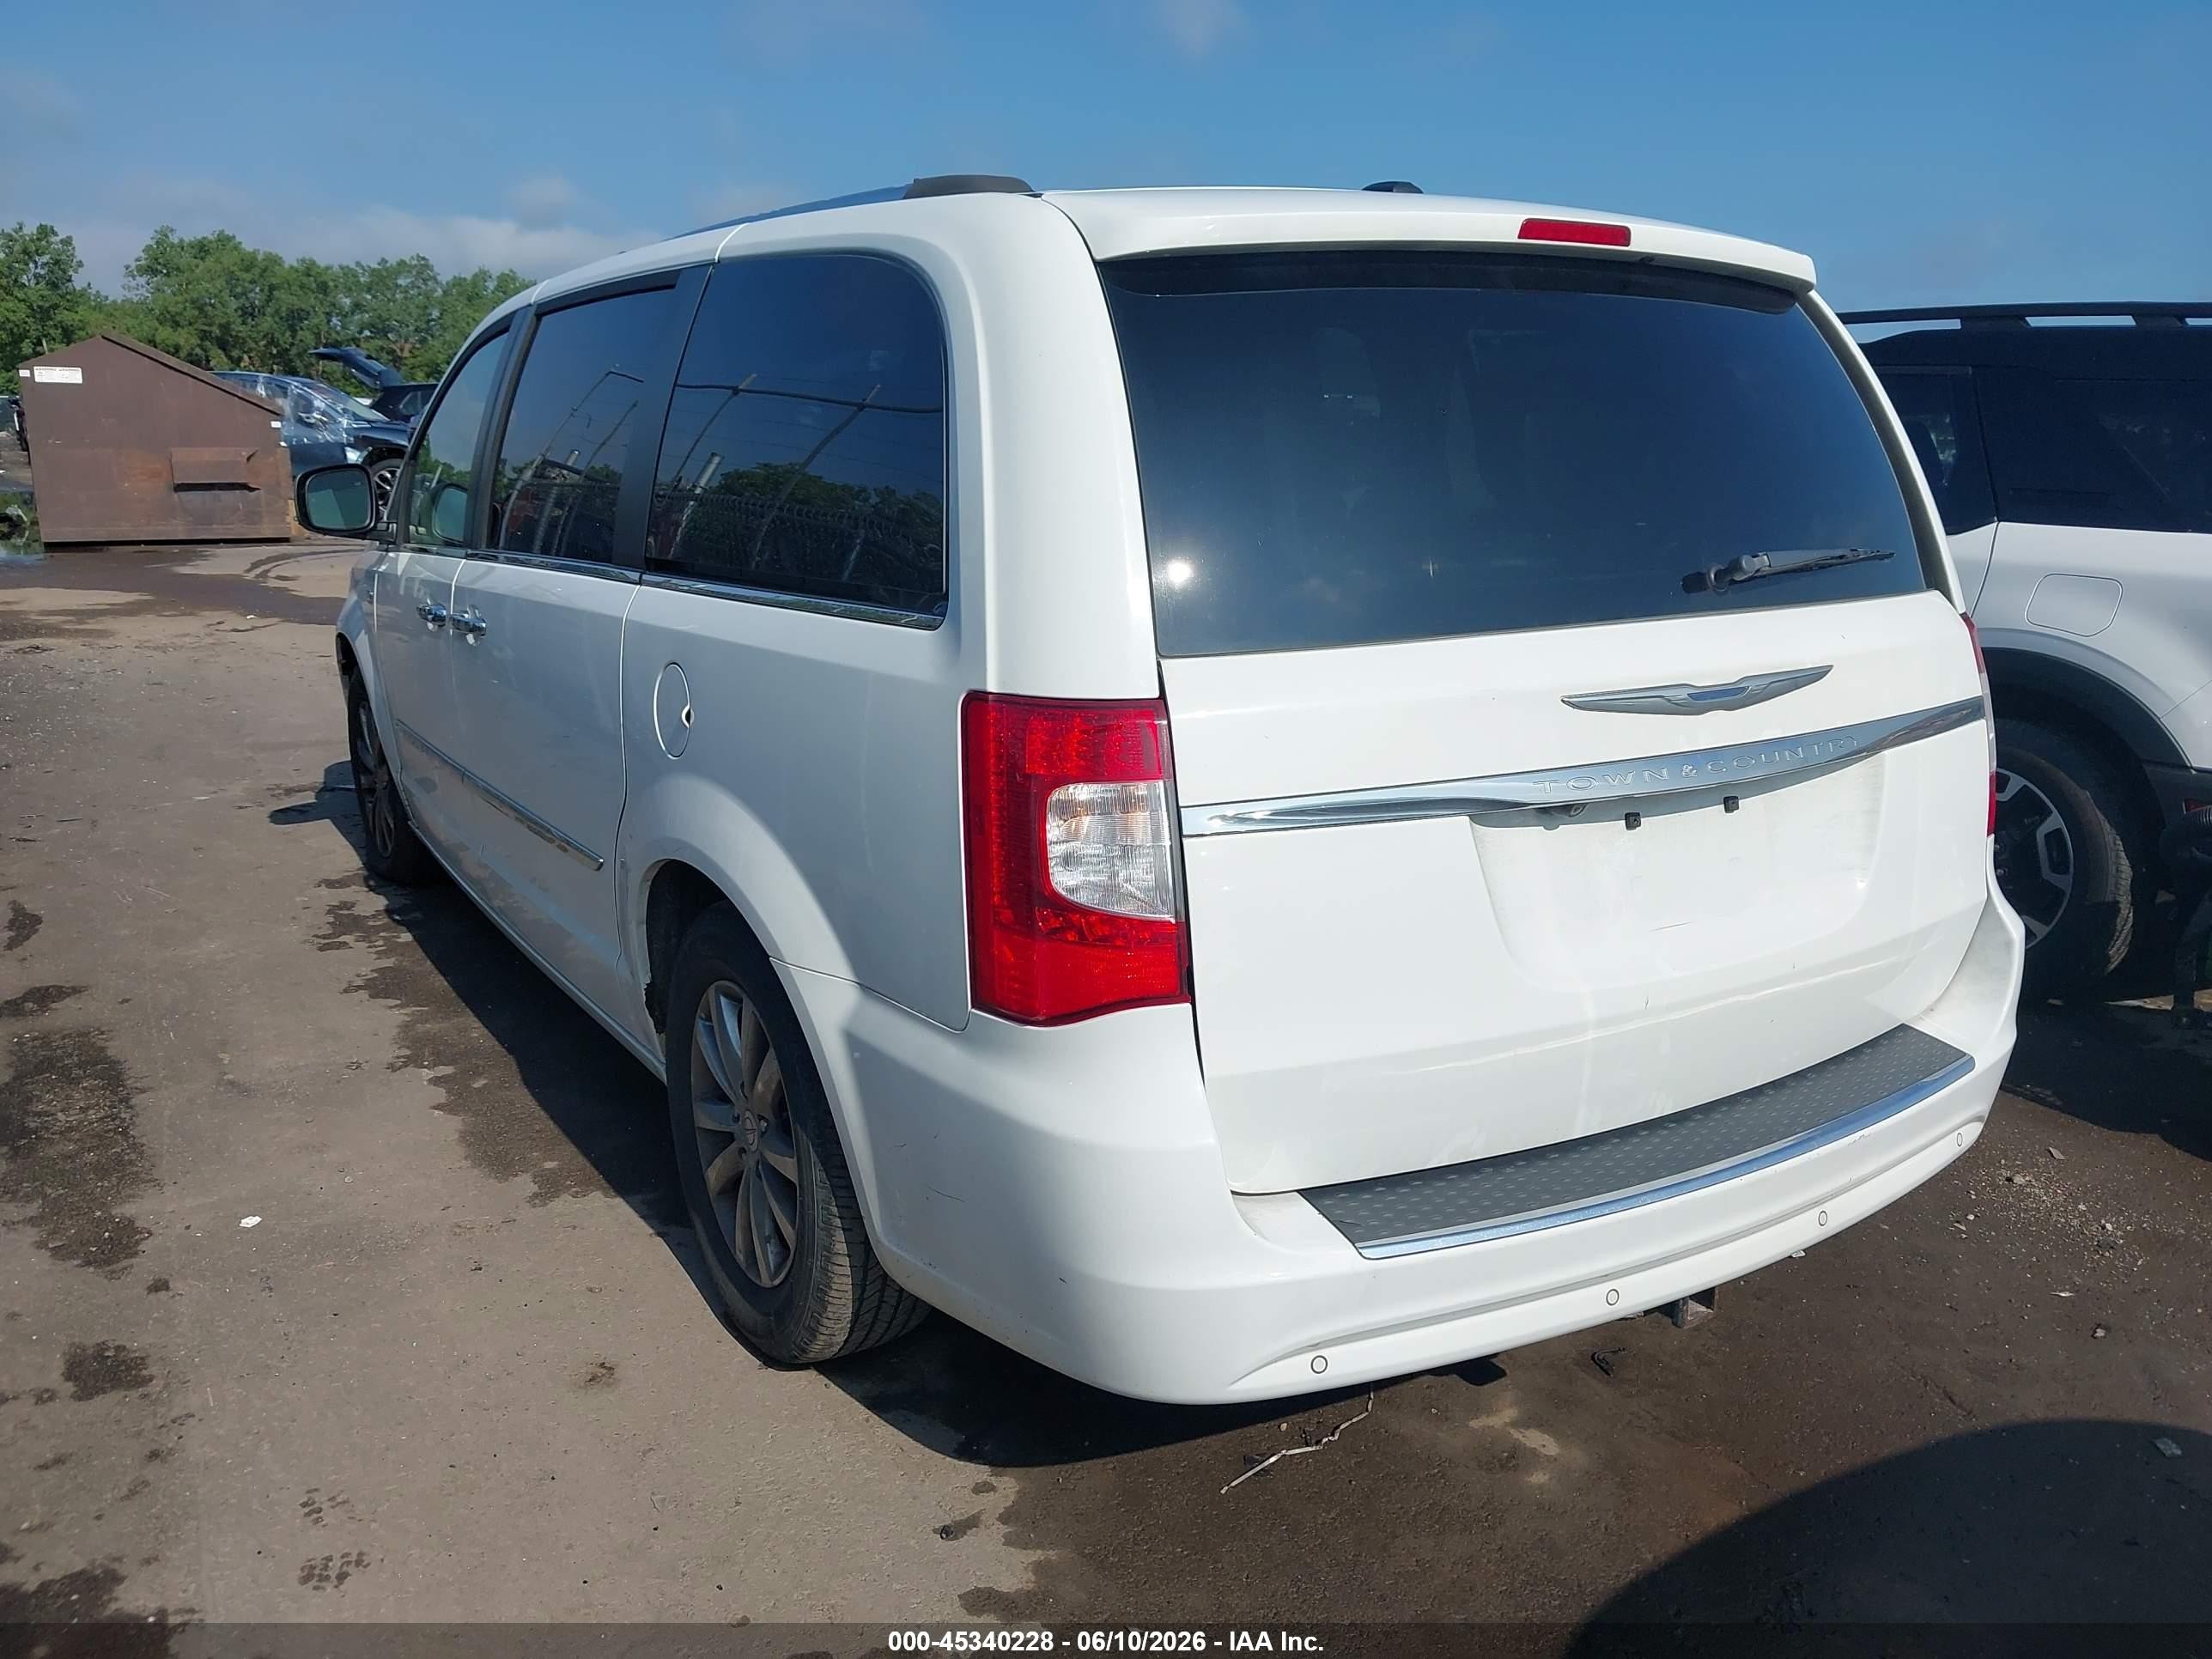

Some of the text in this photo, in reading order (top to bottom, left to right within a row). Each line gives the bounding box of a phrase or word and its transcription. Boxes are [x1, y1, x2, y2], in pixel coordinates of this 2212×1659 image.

[1533, 735, 1858, 794] TOWN & COUNTRY
